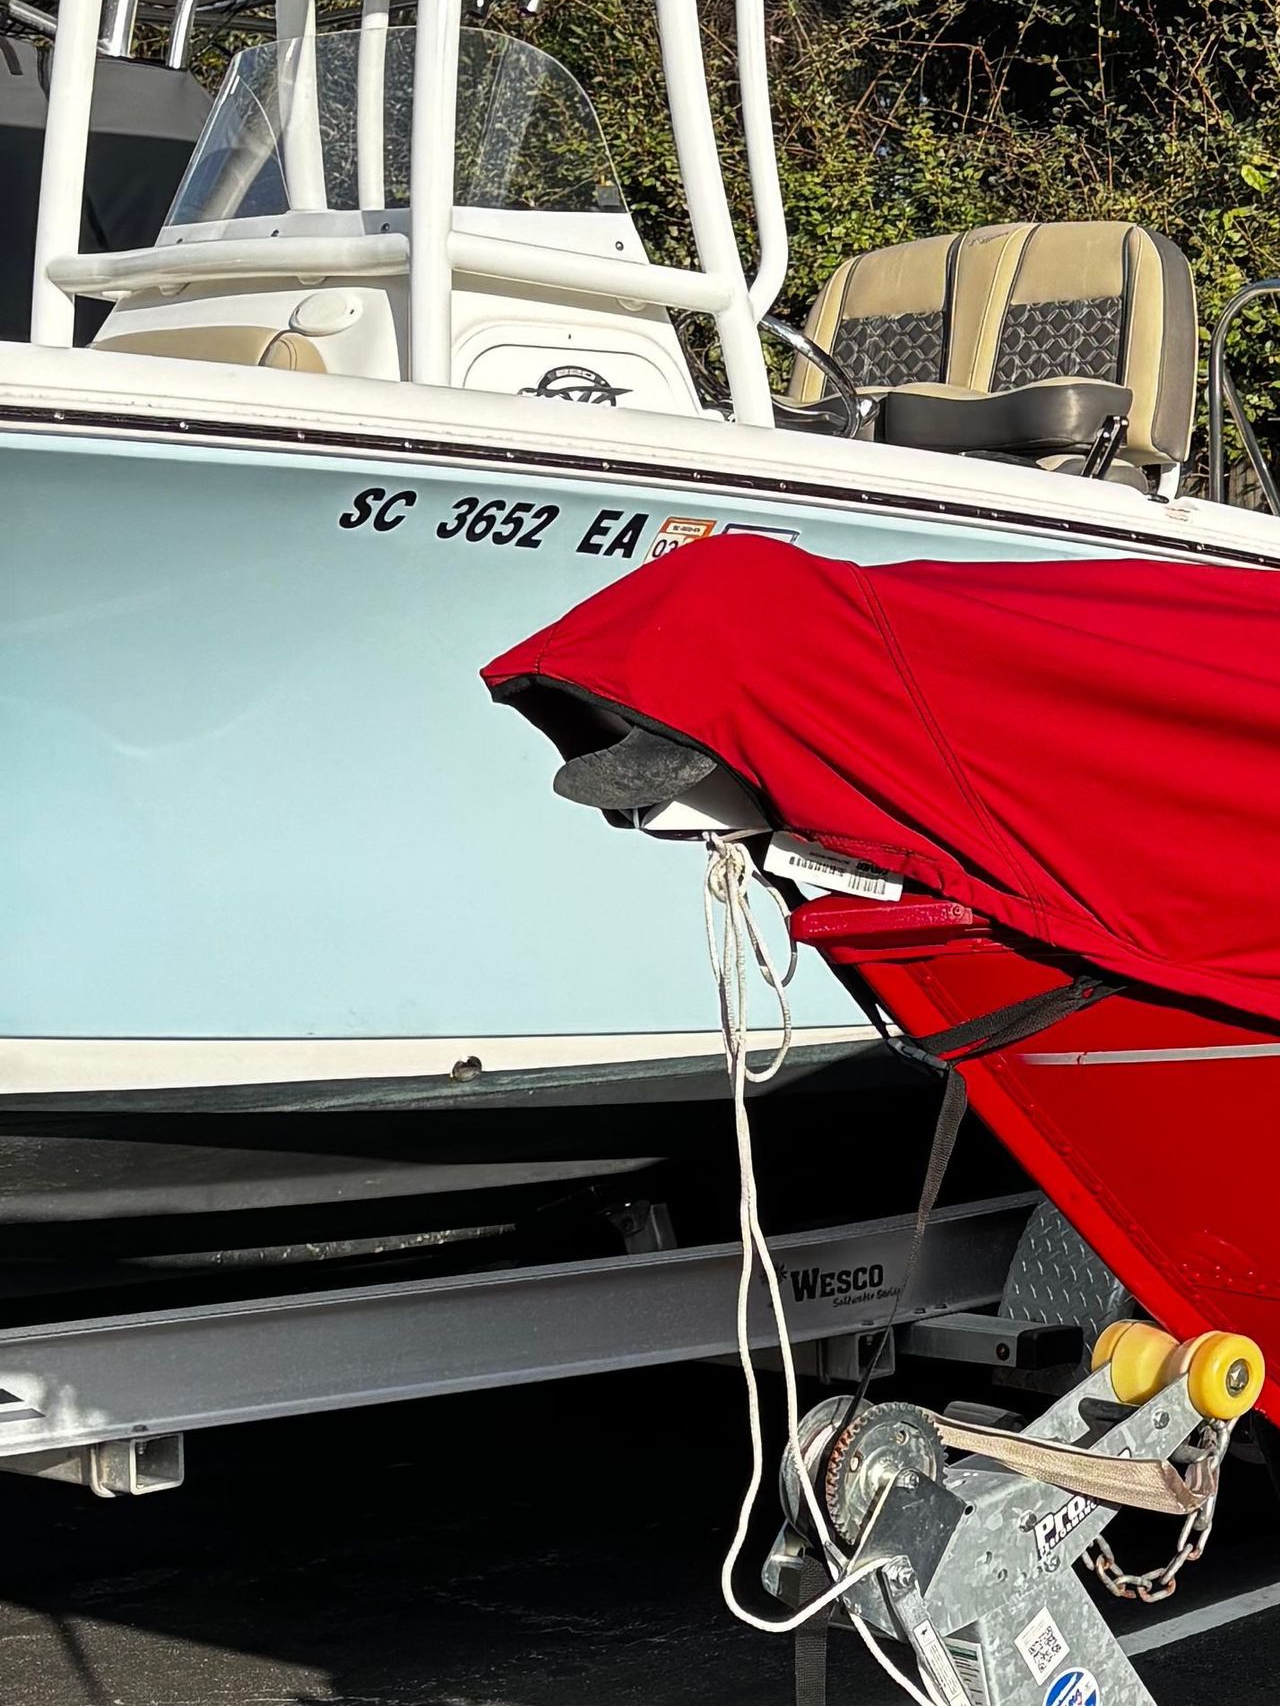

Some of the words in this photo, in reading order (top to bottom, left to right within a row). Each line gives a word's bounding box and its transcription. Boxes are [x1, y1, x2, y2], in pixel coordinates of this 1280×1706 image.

[339, 487, 417, 532] SC
[436, 496, 560, 549] 3652
[575, 509, 649, 558] EA
[790, 1263, 884, 1302] WESCO
